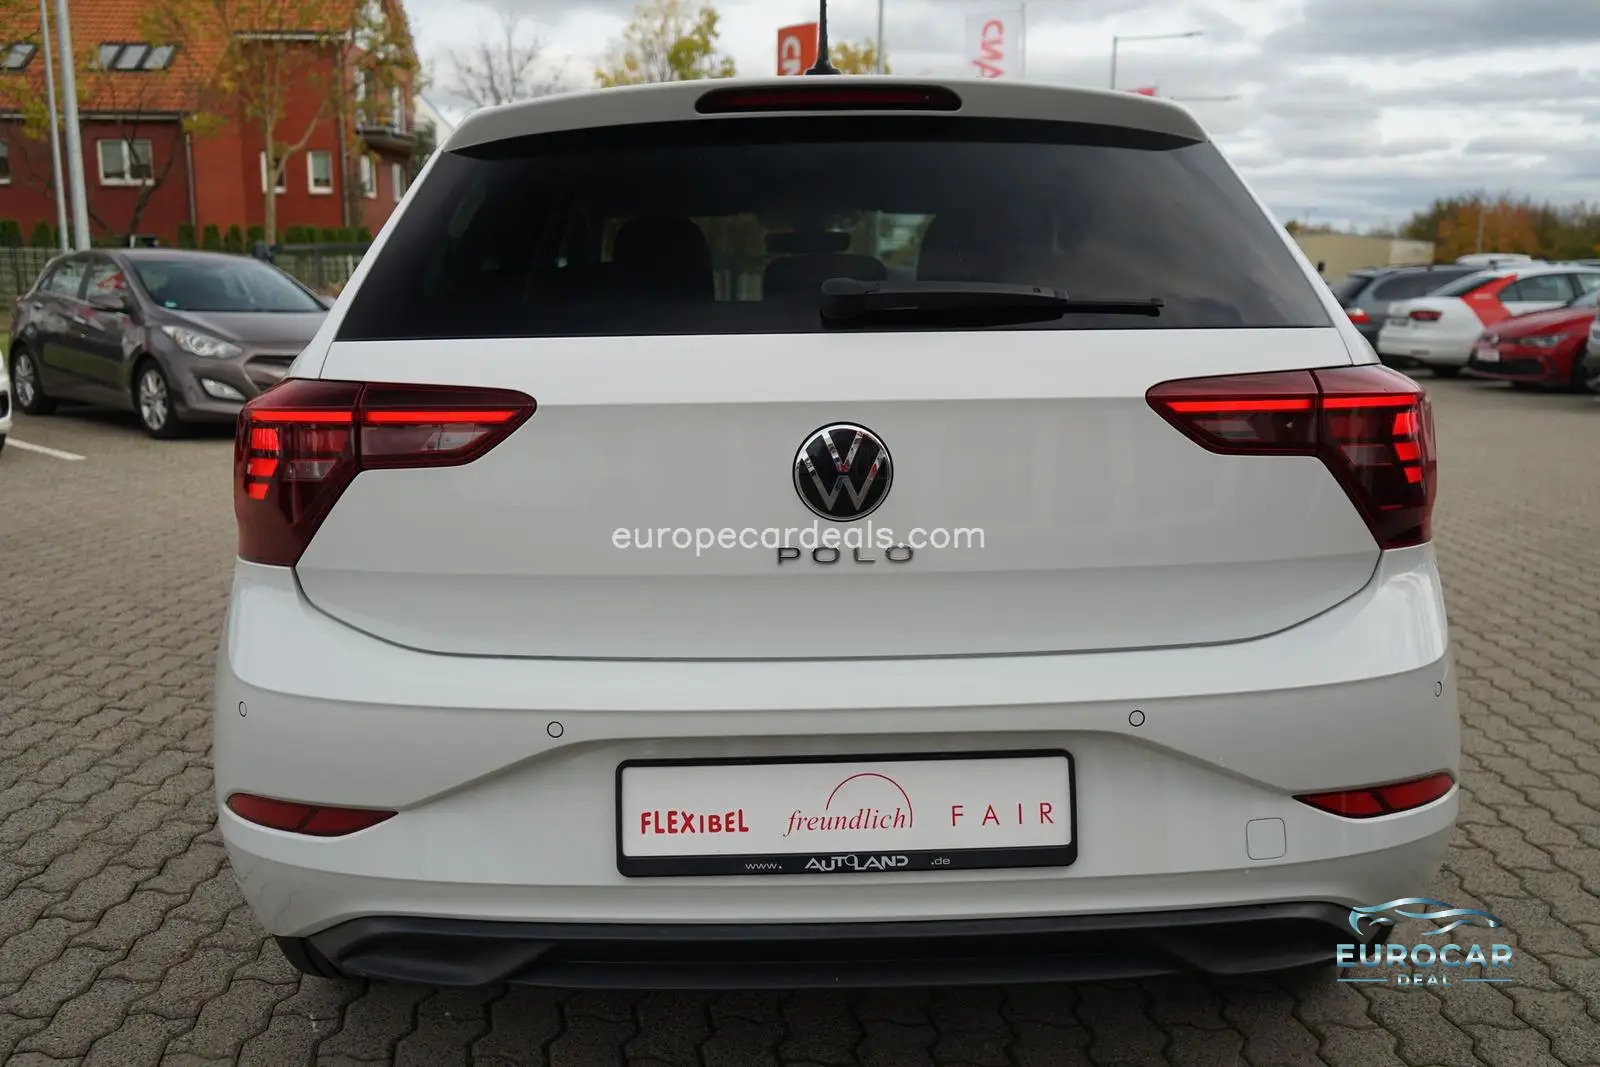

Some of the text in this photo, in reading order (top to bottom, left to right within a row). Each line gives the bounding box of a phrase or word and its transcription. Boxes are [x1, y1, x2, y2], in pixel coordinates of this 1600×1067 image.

[777, 546, 914, 566] POLO
[640, 802, 1055, 838] FLEXIBEL freundlich FAIR
[744, 854, 951, 872] www. AUTOLAND .de
